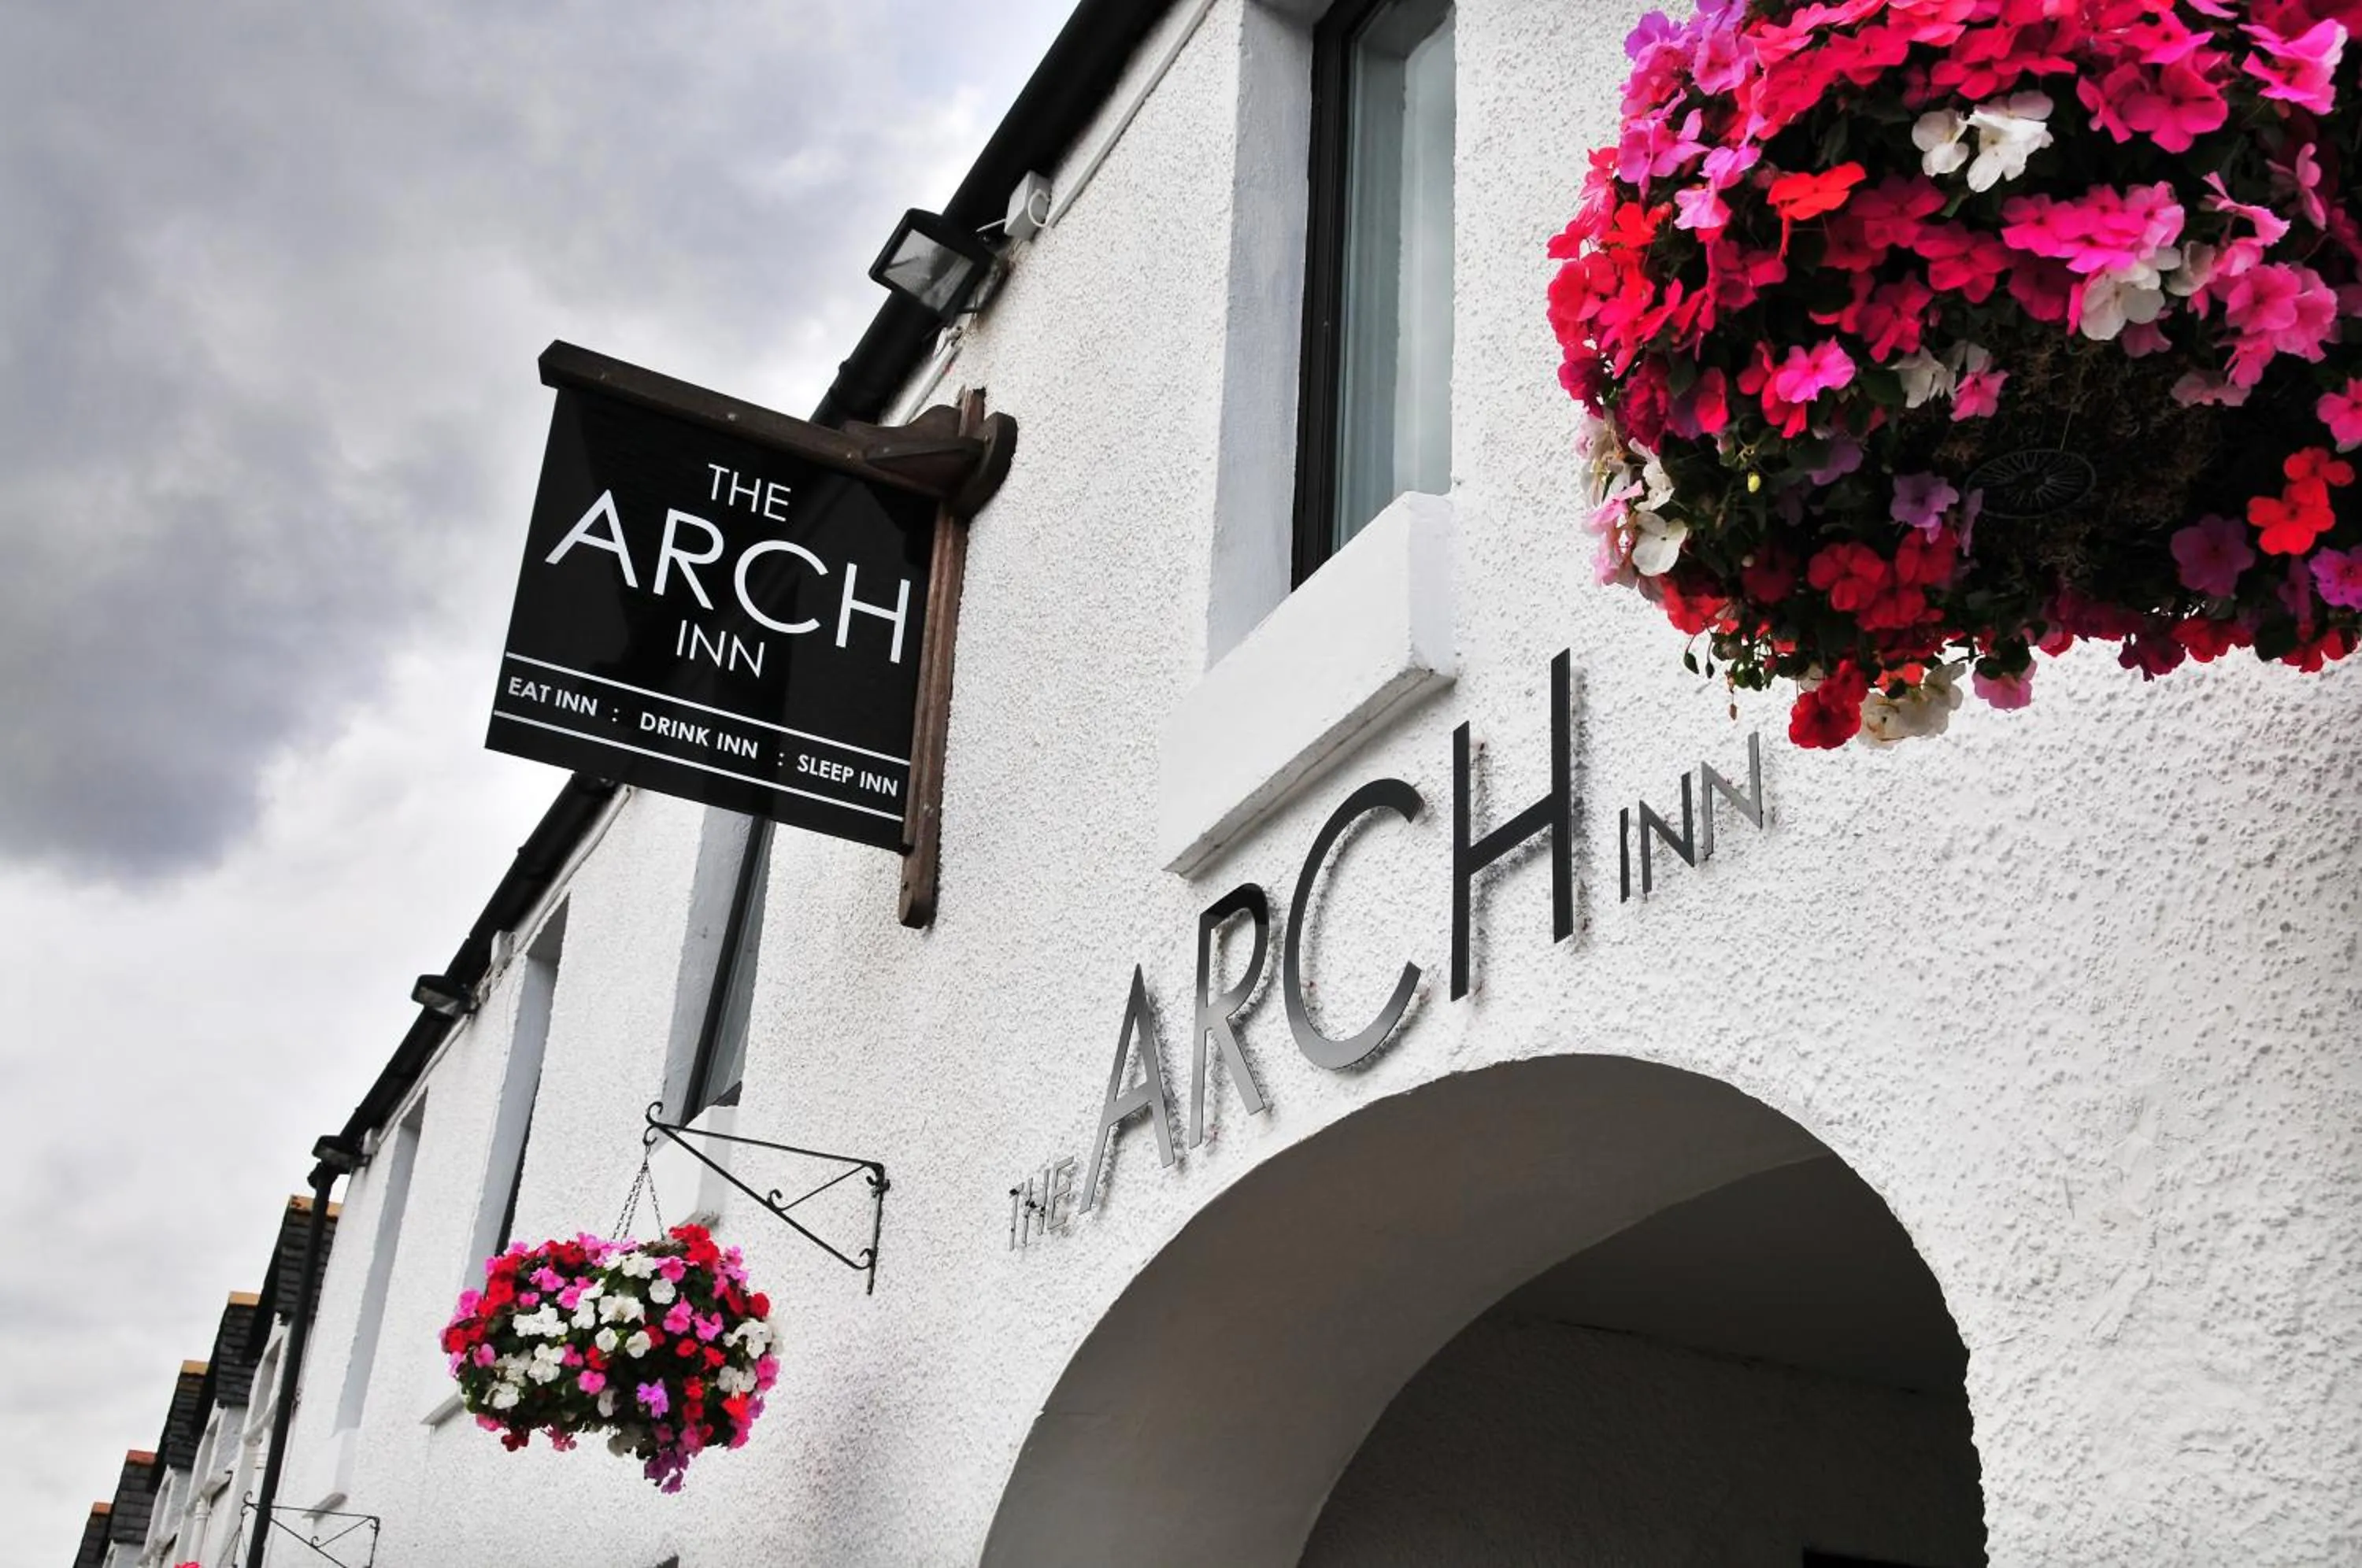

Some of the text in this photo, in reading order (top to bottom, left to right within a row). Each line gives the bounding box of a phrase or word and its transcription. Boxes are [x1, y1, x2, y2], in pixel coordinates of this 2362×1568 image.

[708, 463, 791, 522] THE
[545, 488, 911, 664] ARCH
[676, 619, 765, 679] INN
[508, 676, 552, 704] EAT
[555, 688, 598, 717] INN
[639, 710, 710, 747] DRINK
[716, 734, 759, 760] INN
[797, 753, 855, 784] SLEEP
[860, 775, 899, 797] INN
[1008, 647, 1764, 1252] THE ARCH INN
